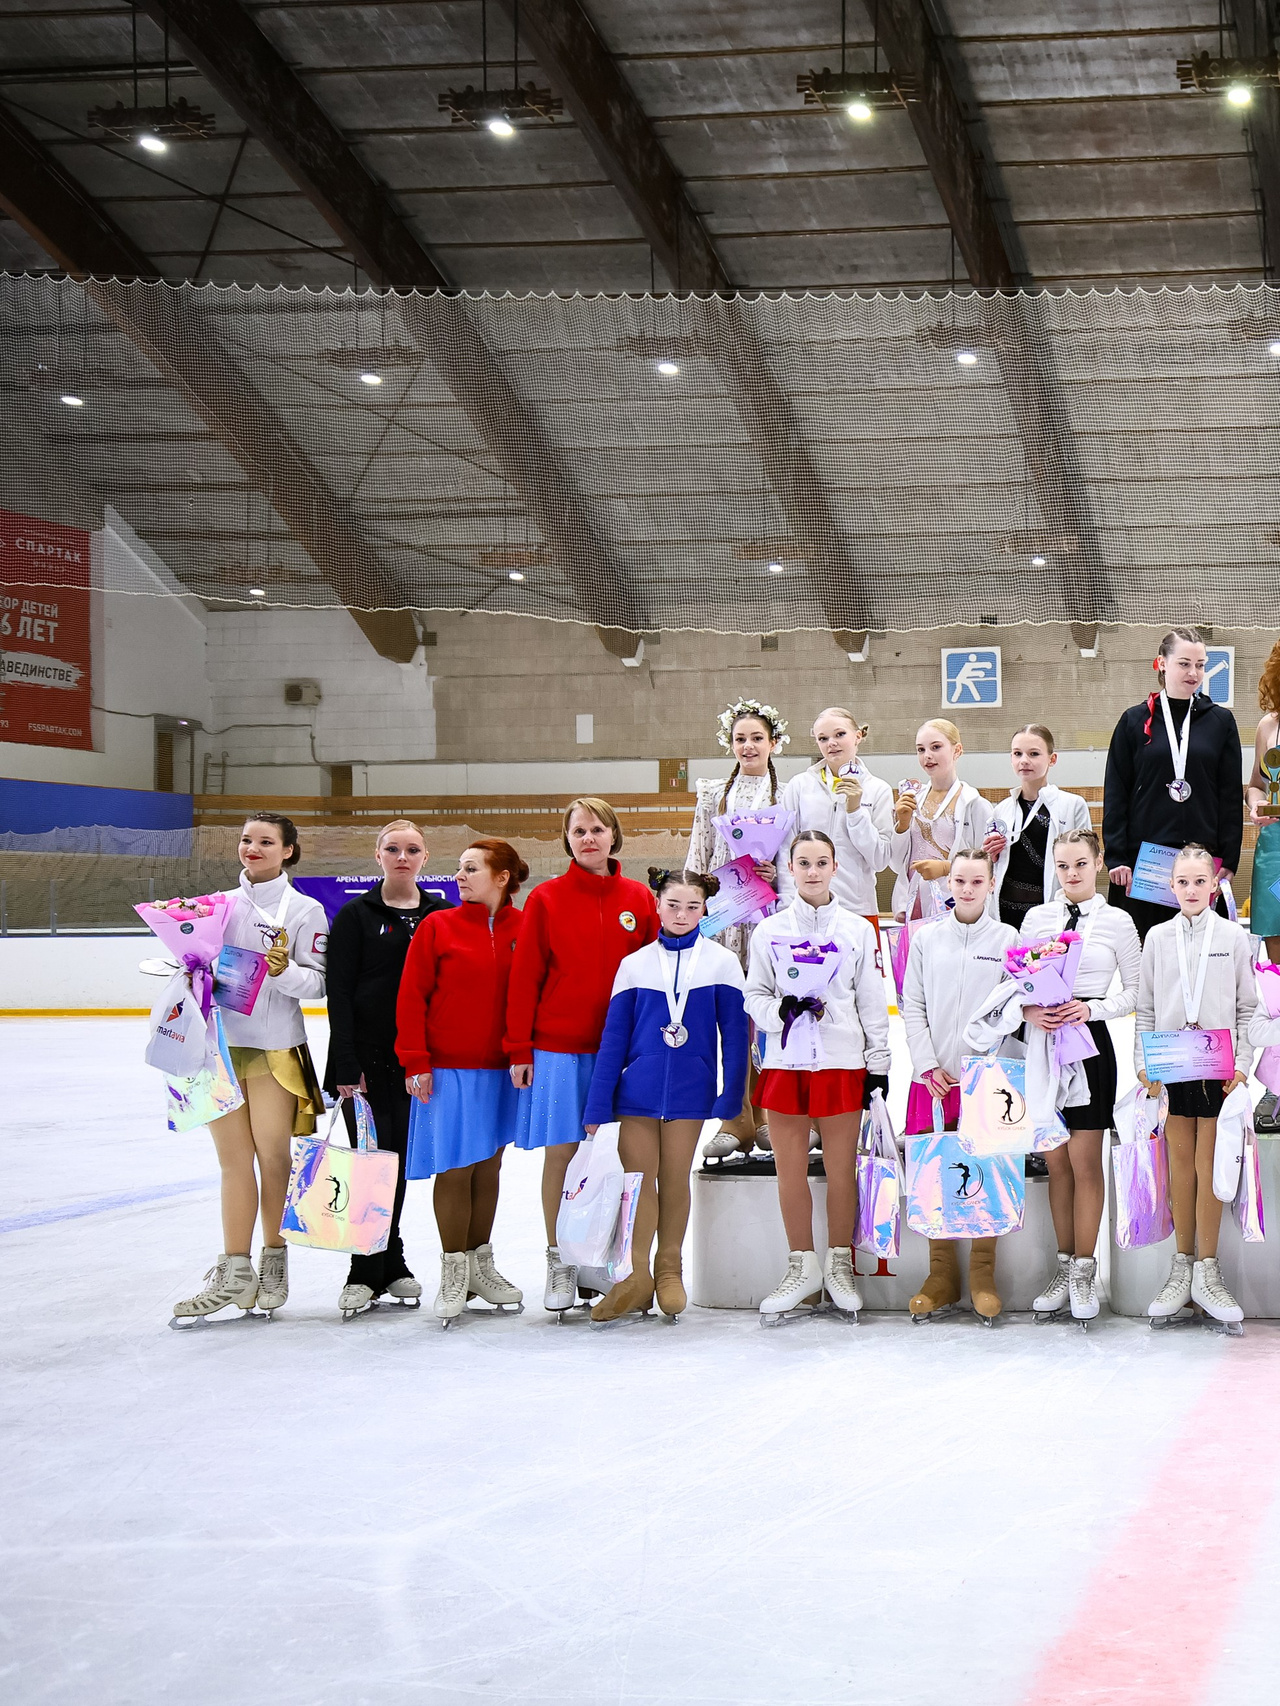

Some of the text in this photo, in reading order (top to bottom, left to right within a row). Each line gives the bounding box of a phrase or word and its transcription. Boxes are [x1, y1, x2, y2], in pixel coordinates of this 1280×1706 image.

[15, 537, 82, 563] СПАРТАК
[21, 599, 58, 618] ДЕТЕЙ
[16, 616, 59, 644] ЛЕТ
